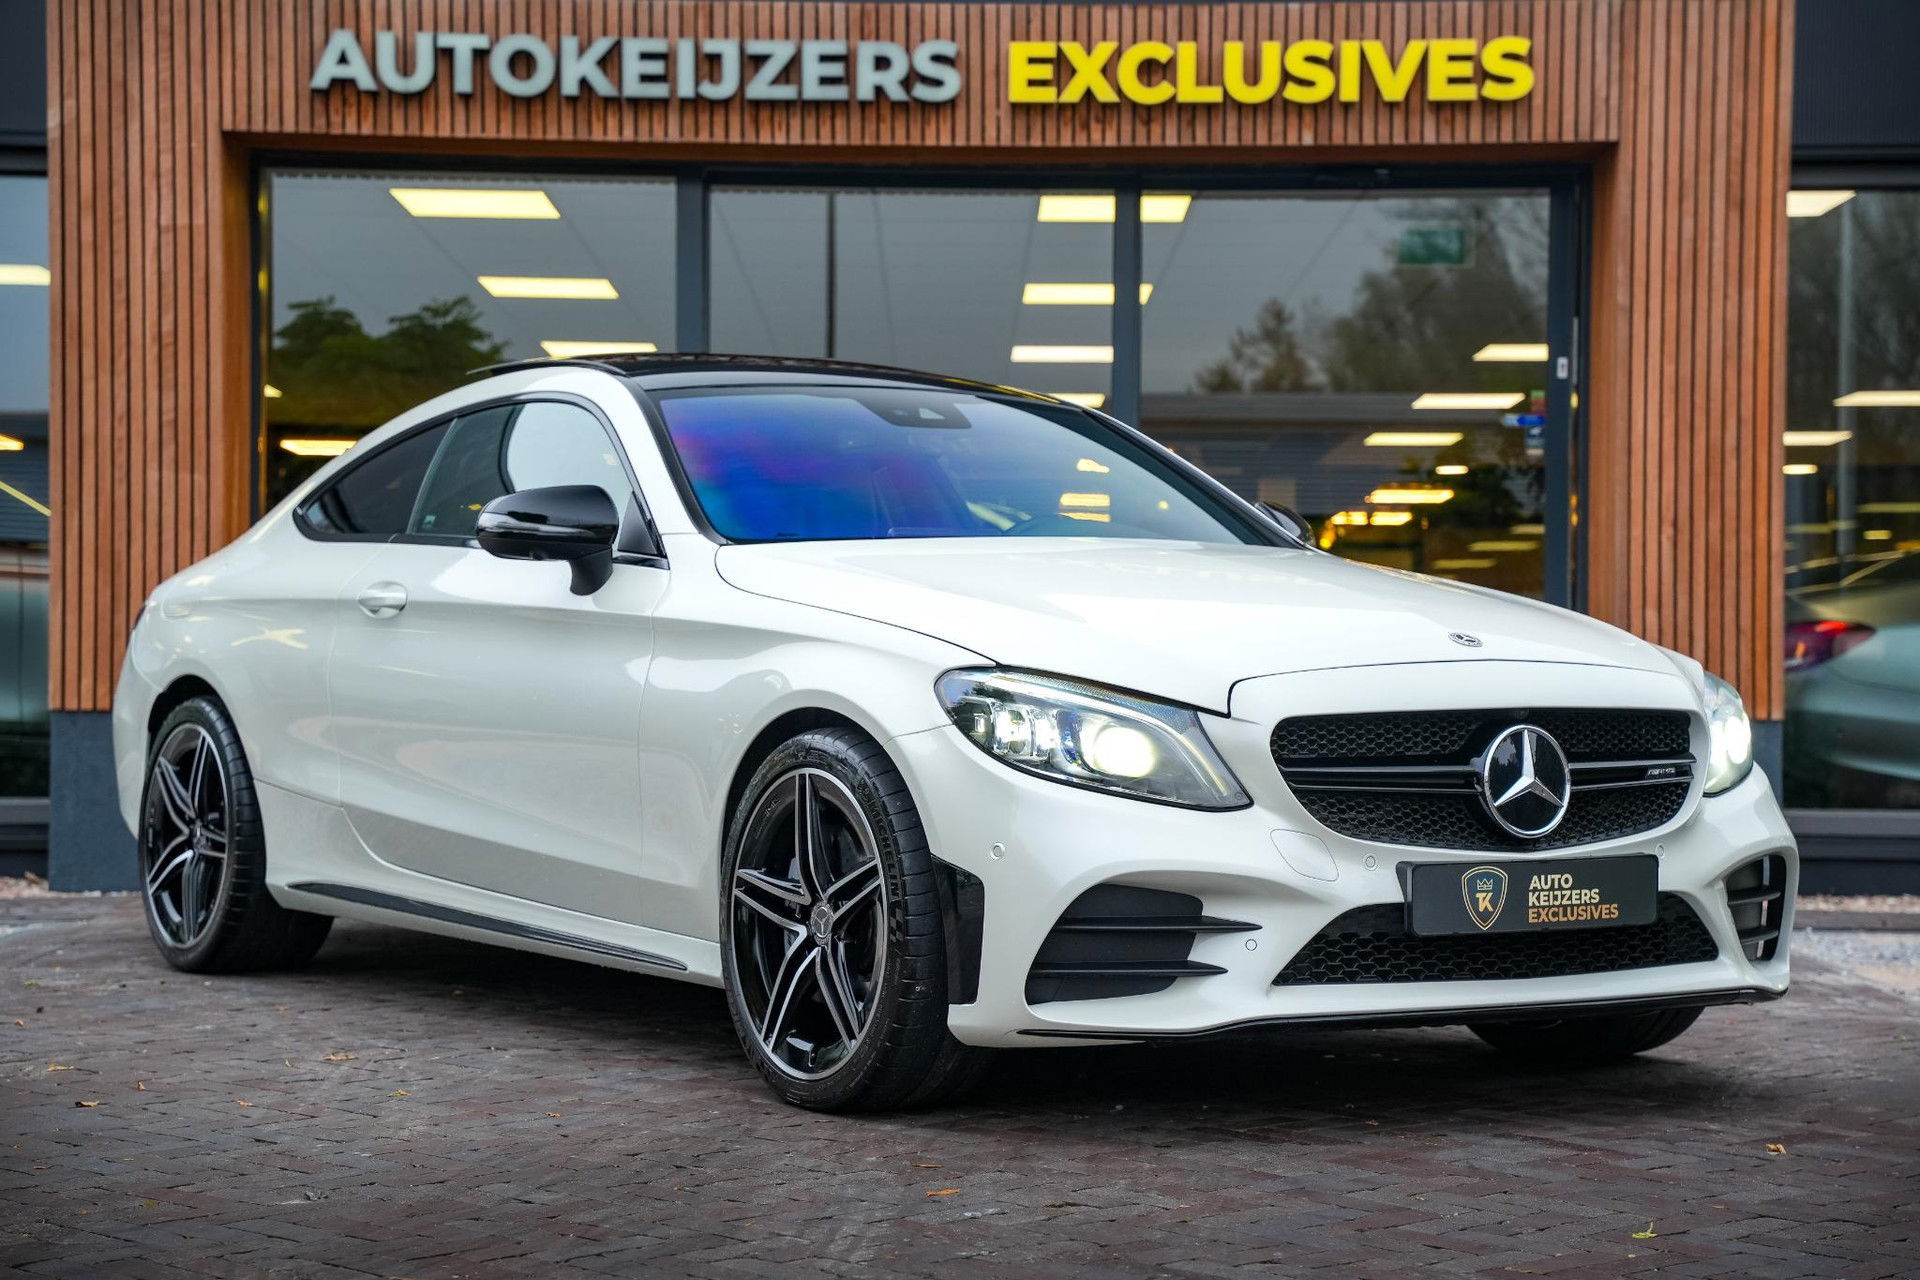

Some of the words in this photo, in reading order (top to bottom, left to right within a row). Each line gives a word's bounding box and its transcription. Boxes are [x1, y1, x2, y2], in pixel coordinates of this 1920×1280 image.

[310, 29, 962, 104] AUTOKEIJZERS
[1008, 36, 1535, 104] EXCLUSIVES
[1529, 873, 1573, 890] AUTO
[1528, 889, 1600, 907] KEIJZERS
[1528, 904, 1618, 923] EXCLUSIVES
